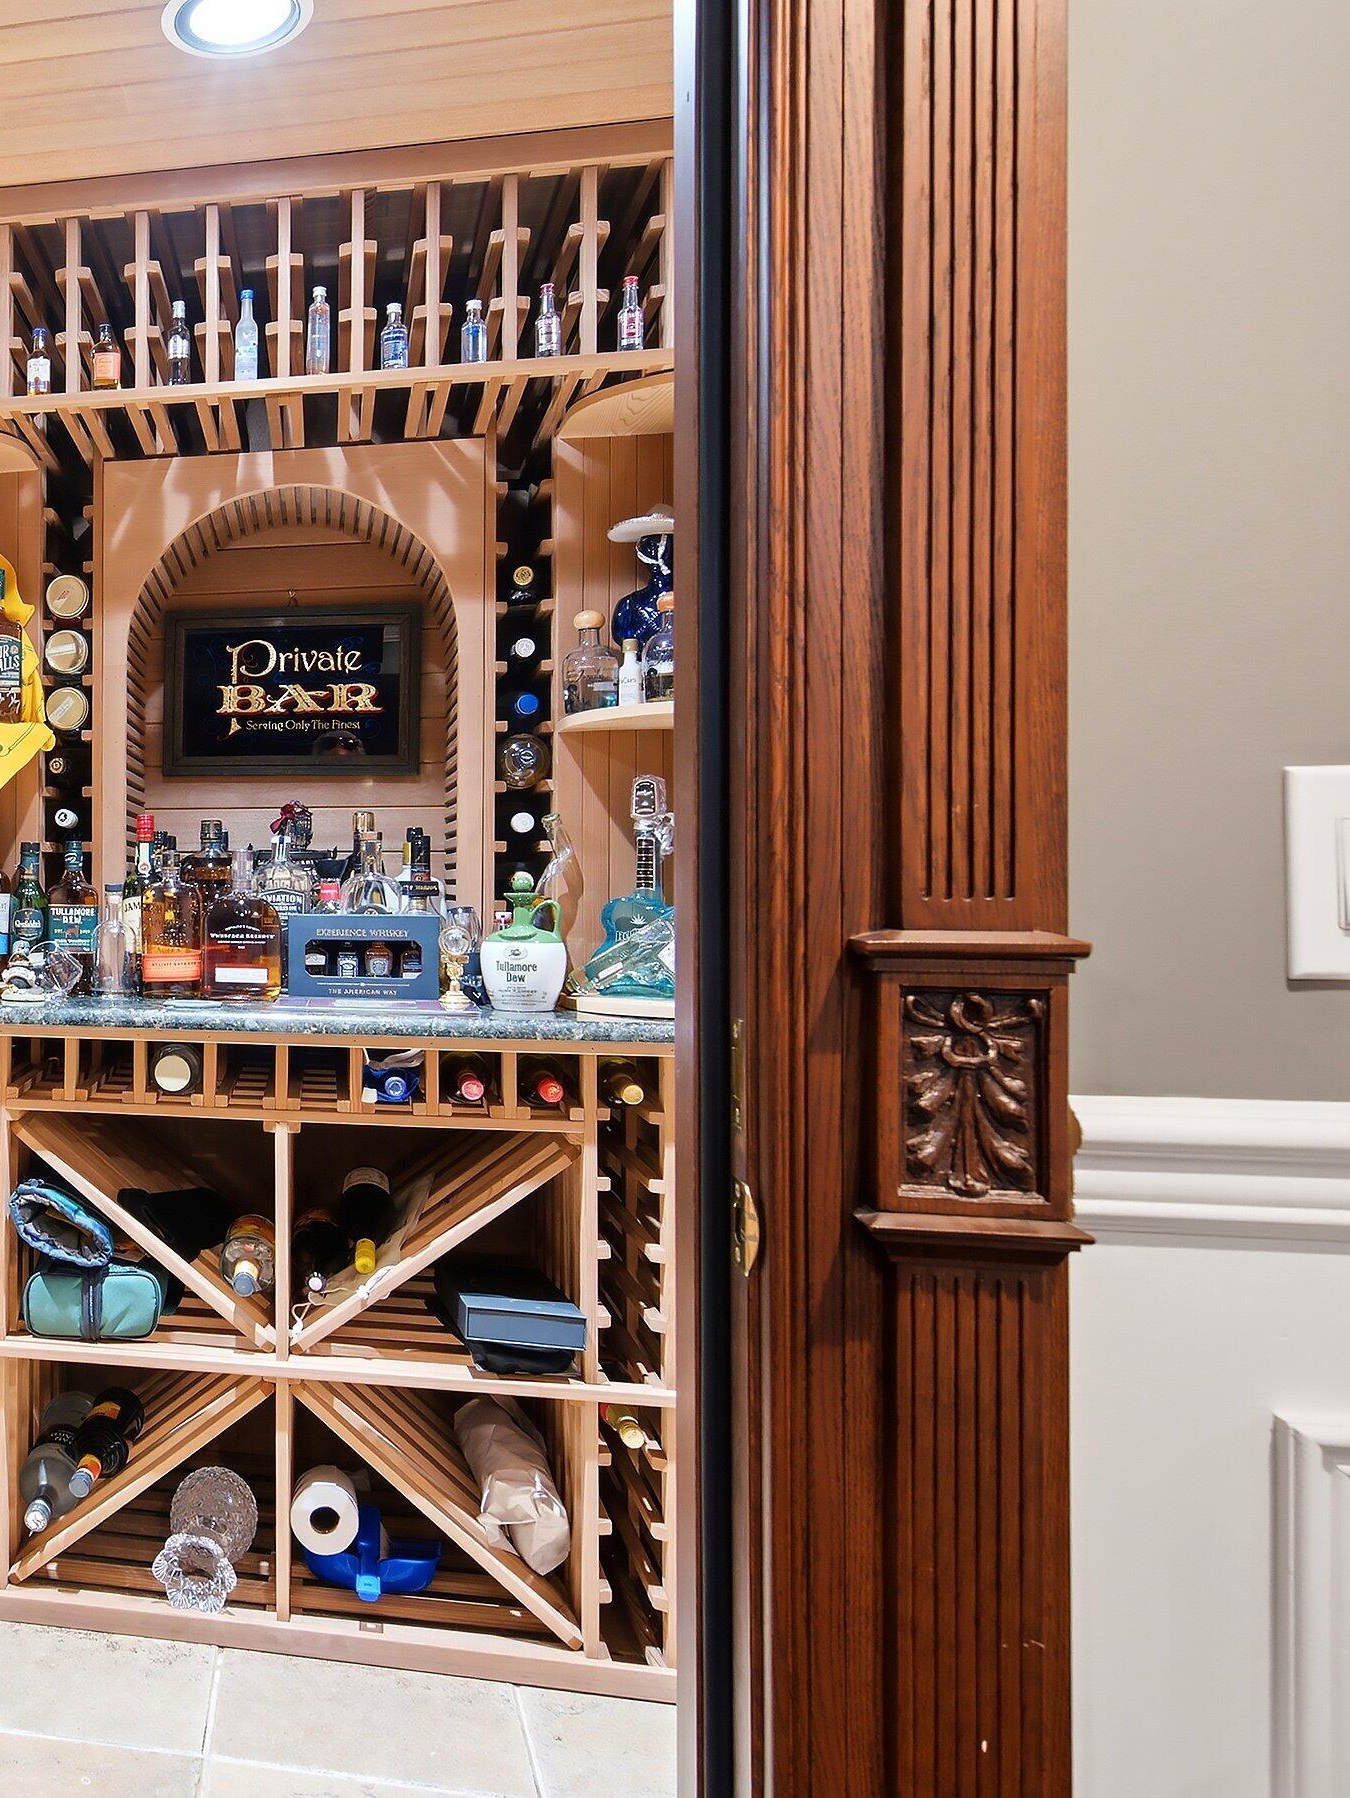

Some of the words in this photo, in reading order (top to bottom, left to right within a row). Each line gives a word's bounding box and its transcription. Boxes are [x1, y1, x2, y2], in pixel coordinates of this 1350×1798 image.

[226, 639, 362, 684] Private
[216, 683, 383, 716] BAR
[246, 719, 283, 732] Serving
[285, 719, 310, 732] Only
[311, 719, 330, 730] The
[332, 719, 361, 730] Finest
[50, 907, 95, 917] TULLAMORE
[124, 901, 141, 912] JAM
[316, 928, 367, 937] EXPERIENCE
[370, 928, 410, 938] WHISKEY
[496, 960, 538, 972] Tullamore
[506, 972, 526, 983] Dew
[343, 988, 381, 996] AMERICAN
